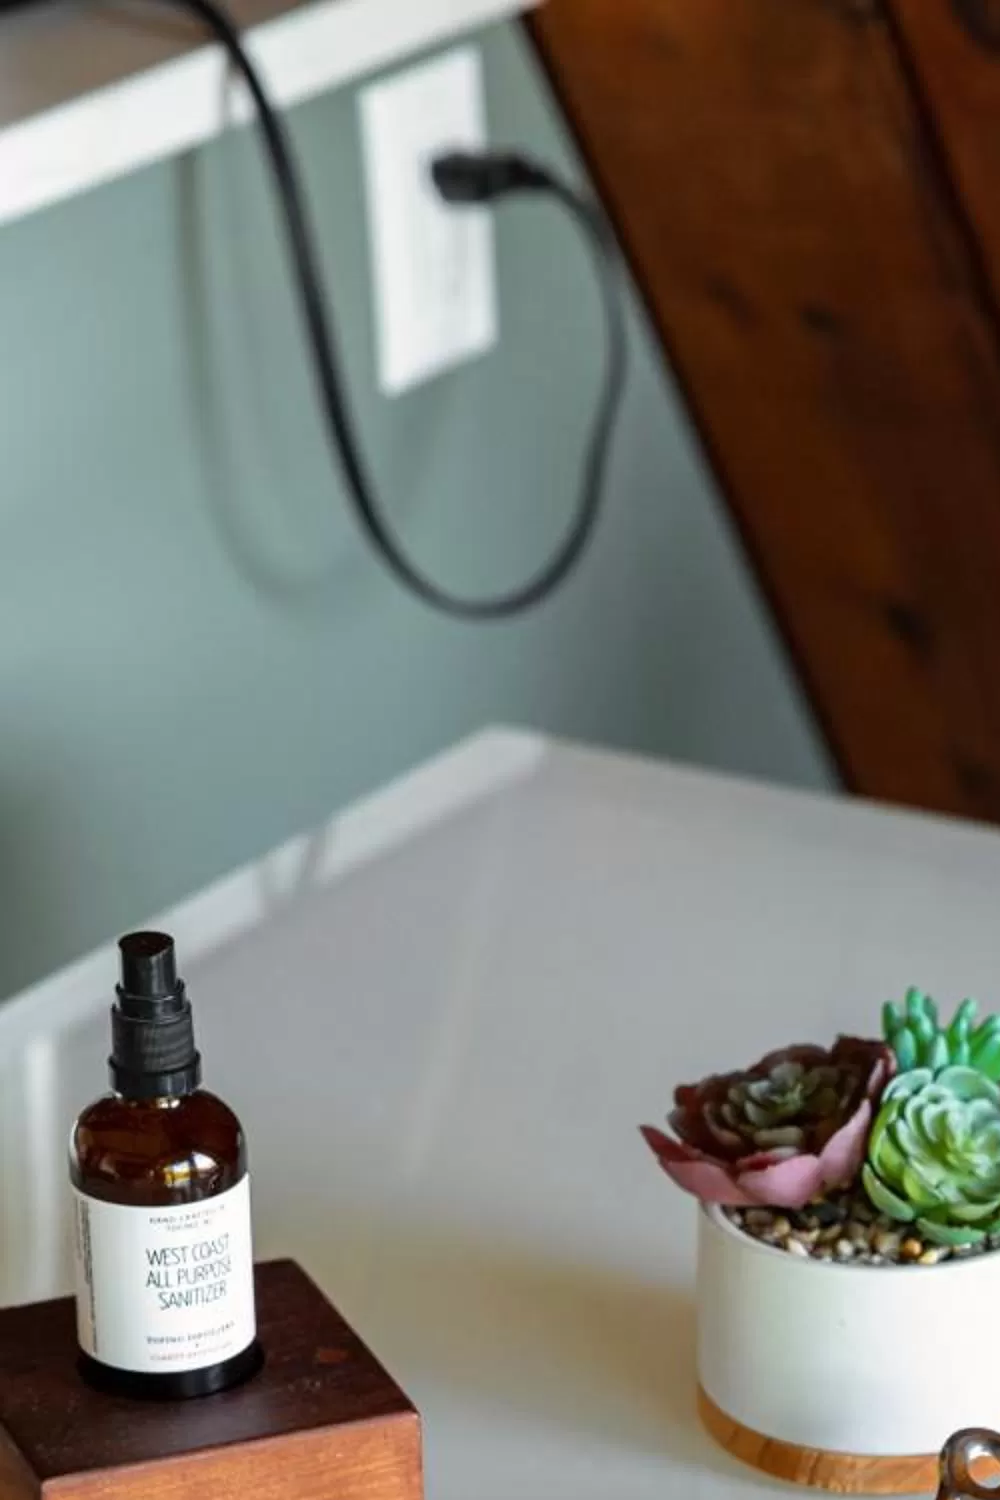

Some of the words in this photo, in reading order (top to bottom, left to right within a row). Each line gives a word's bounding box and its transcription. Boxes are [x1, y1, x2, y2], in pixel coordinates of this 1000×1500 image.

[145, 1246, 188, 1267] WEST
[191, 1232, 230, 1260] COAST
[145, 1270, 174, 1289] ALL
[176, 1256, 232, 1285] PURPOSE
[159, 1280, 227, 1312] SANITIZER
